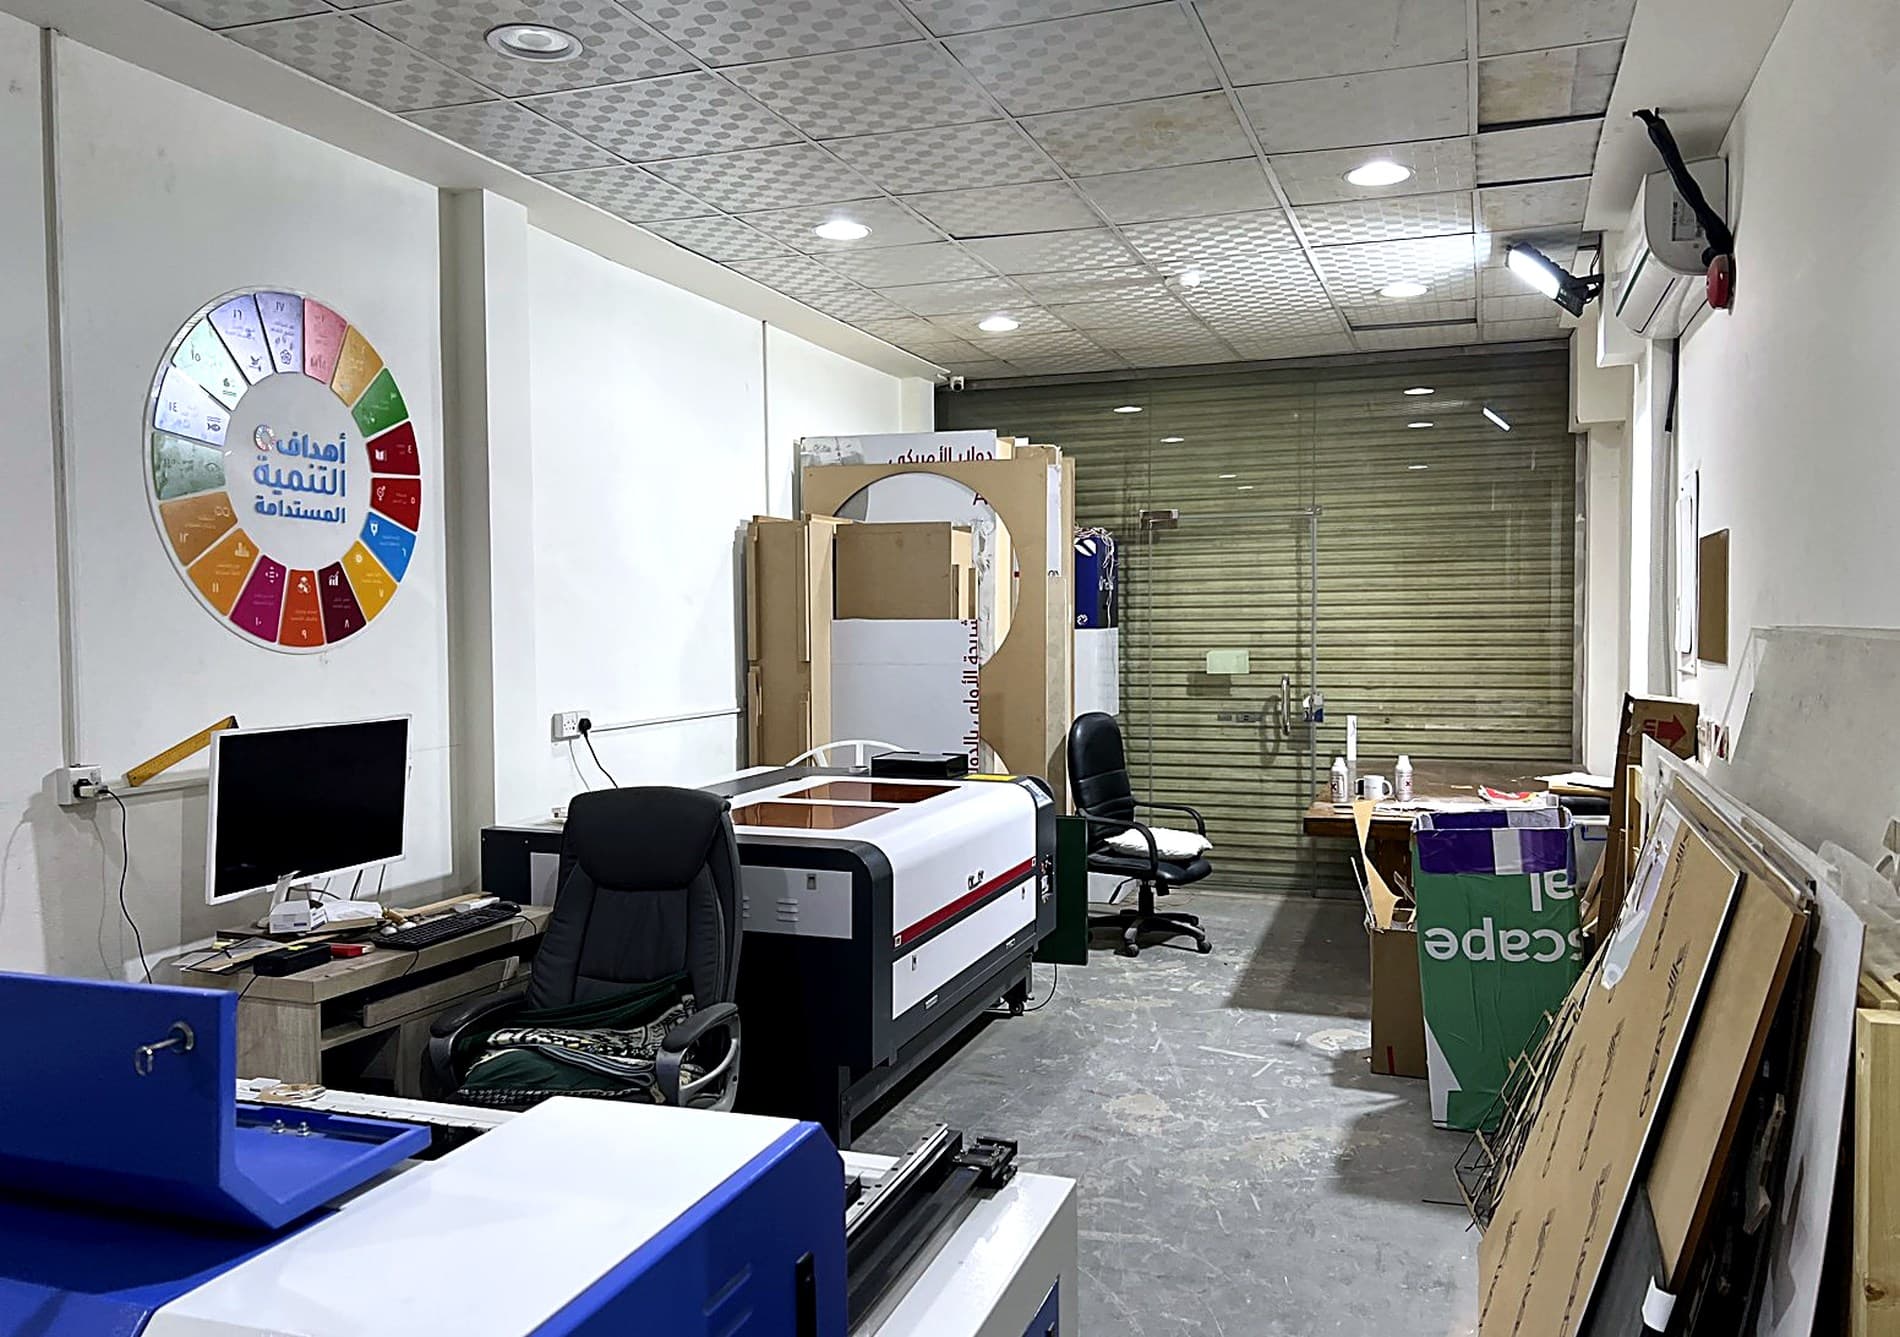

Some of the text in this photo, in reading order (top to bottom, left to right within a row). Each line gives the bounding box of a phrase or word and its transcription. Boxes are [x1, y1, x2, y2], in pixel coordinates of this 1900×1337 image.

[276, 432, 346, 464] أهداف
[254, 455, 346, 497] التنمية
[255, 495, 346, 523] المستدامة
